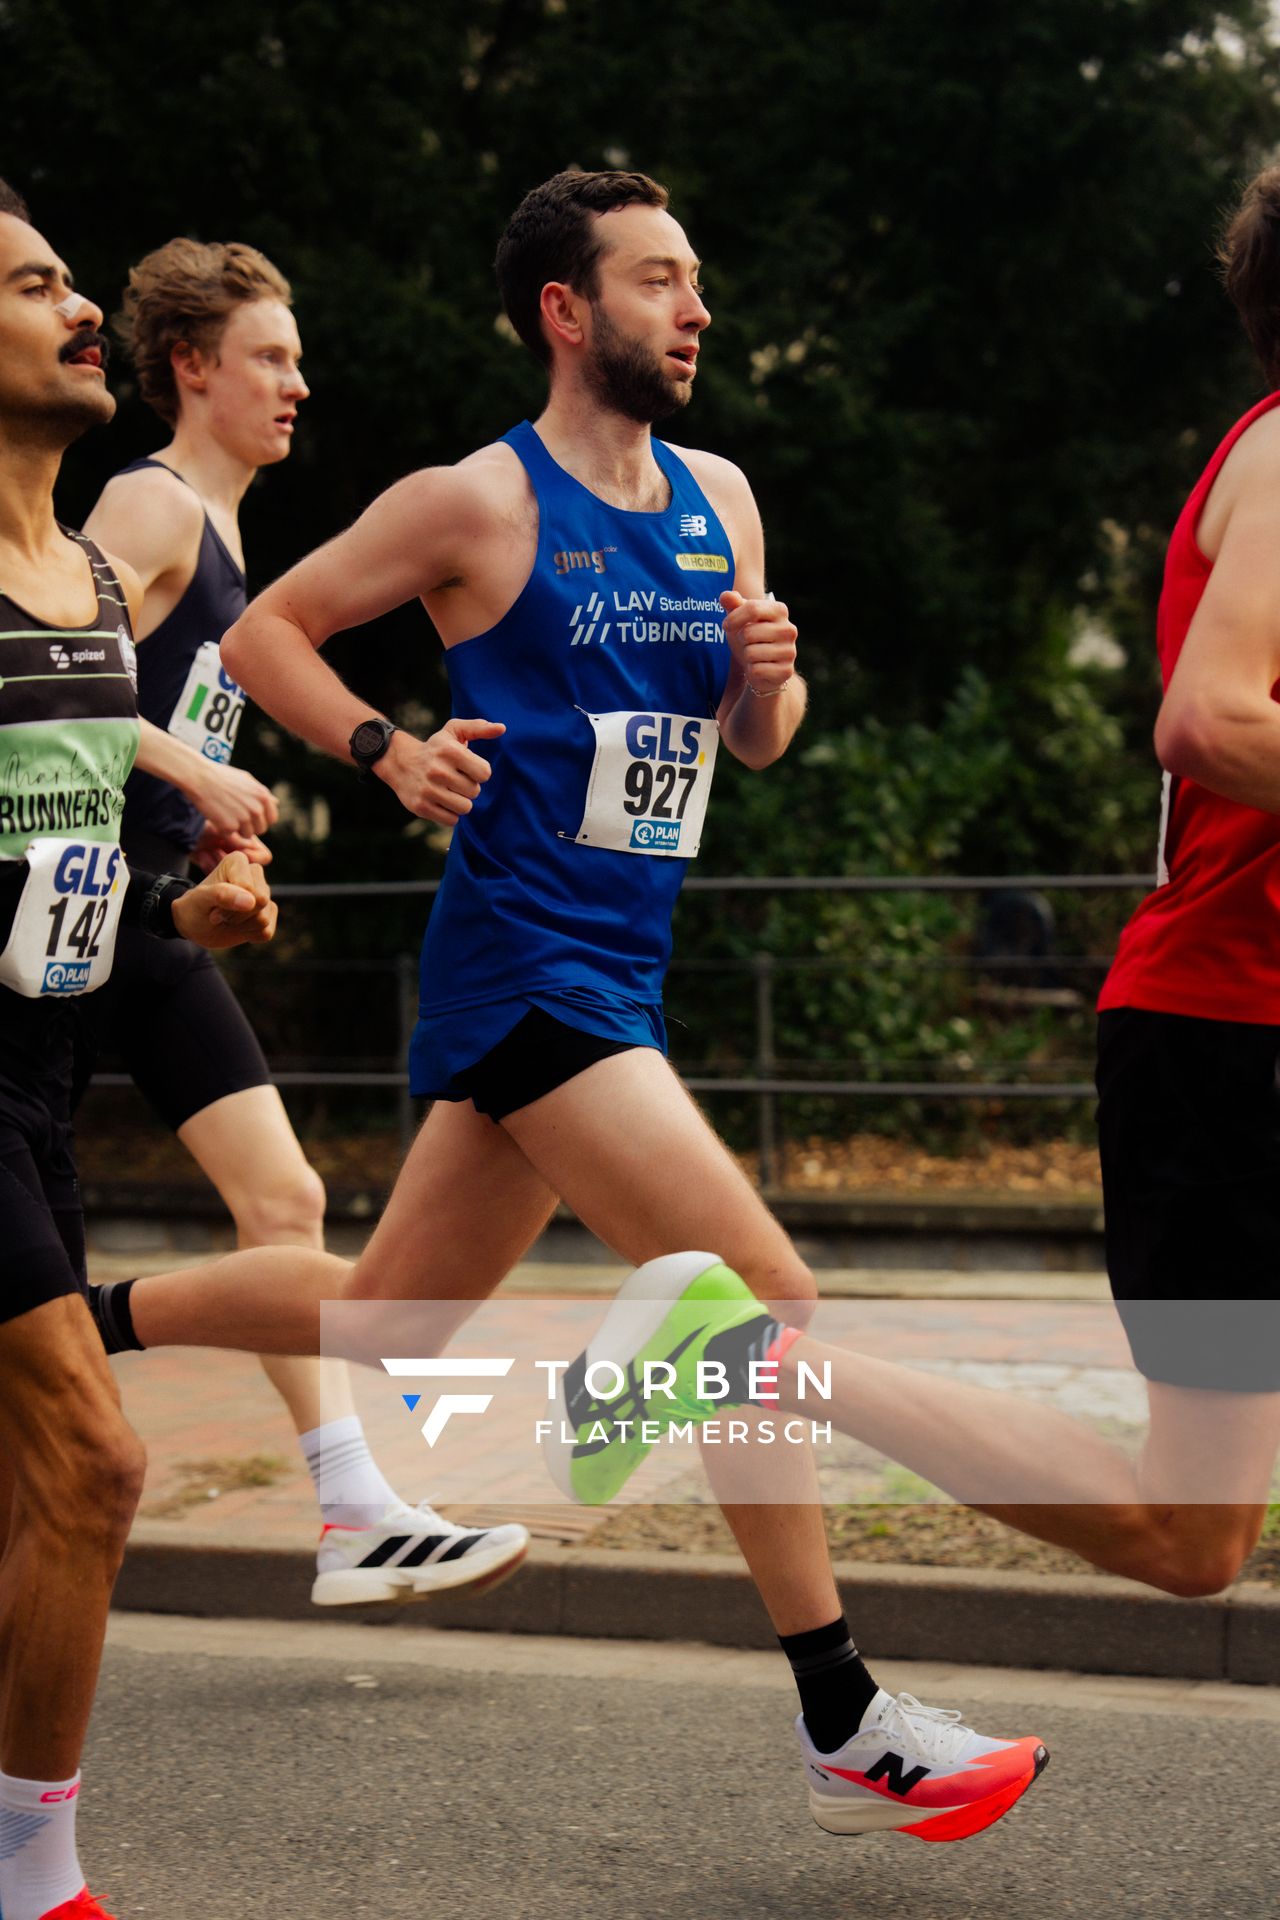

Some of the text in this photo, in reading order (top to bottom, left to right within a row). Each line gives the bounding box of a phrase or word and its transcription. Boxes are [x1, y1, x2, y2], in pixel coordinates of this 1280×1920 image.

[553, 550, 606, 574] gmg
[690, 556, 716, 568] HORN
[613, 591, 656, 612] LAV
[616, 616, 725, 644] TÜBINGEN
[72, 648, 105, 663] spized
[623, 760, 698, 820] 927
[0, 787, 112, 834] RUNNERS
[655, 826, 679, 841] PLAN
[46, 896, 108, 959] 142
[65, 967, 90, 982] PLAN
